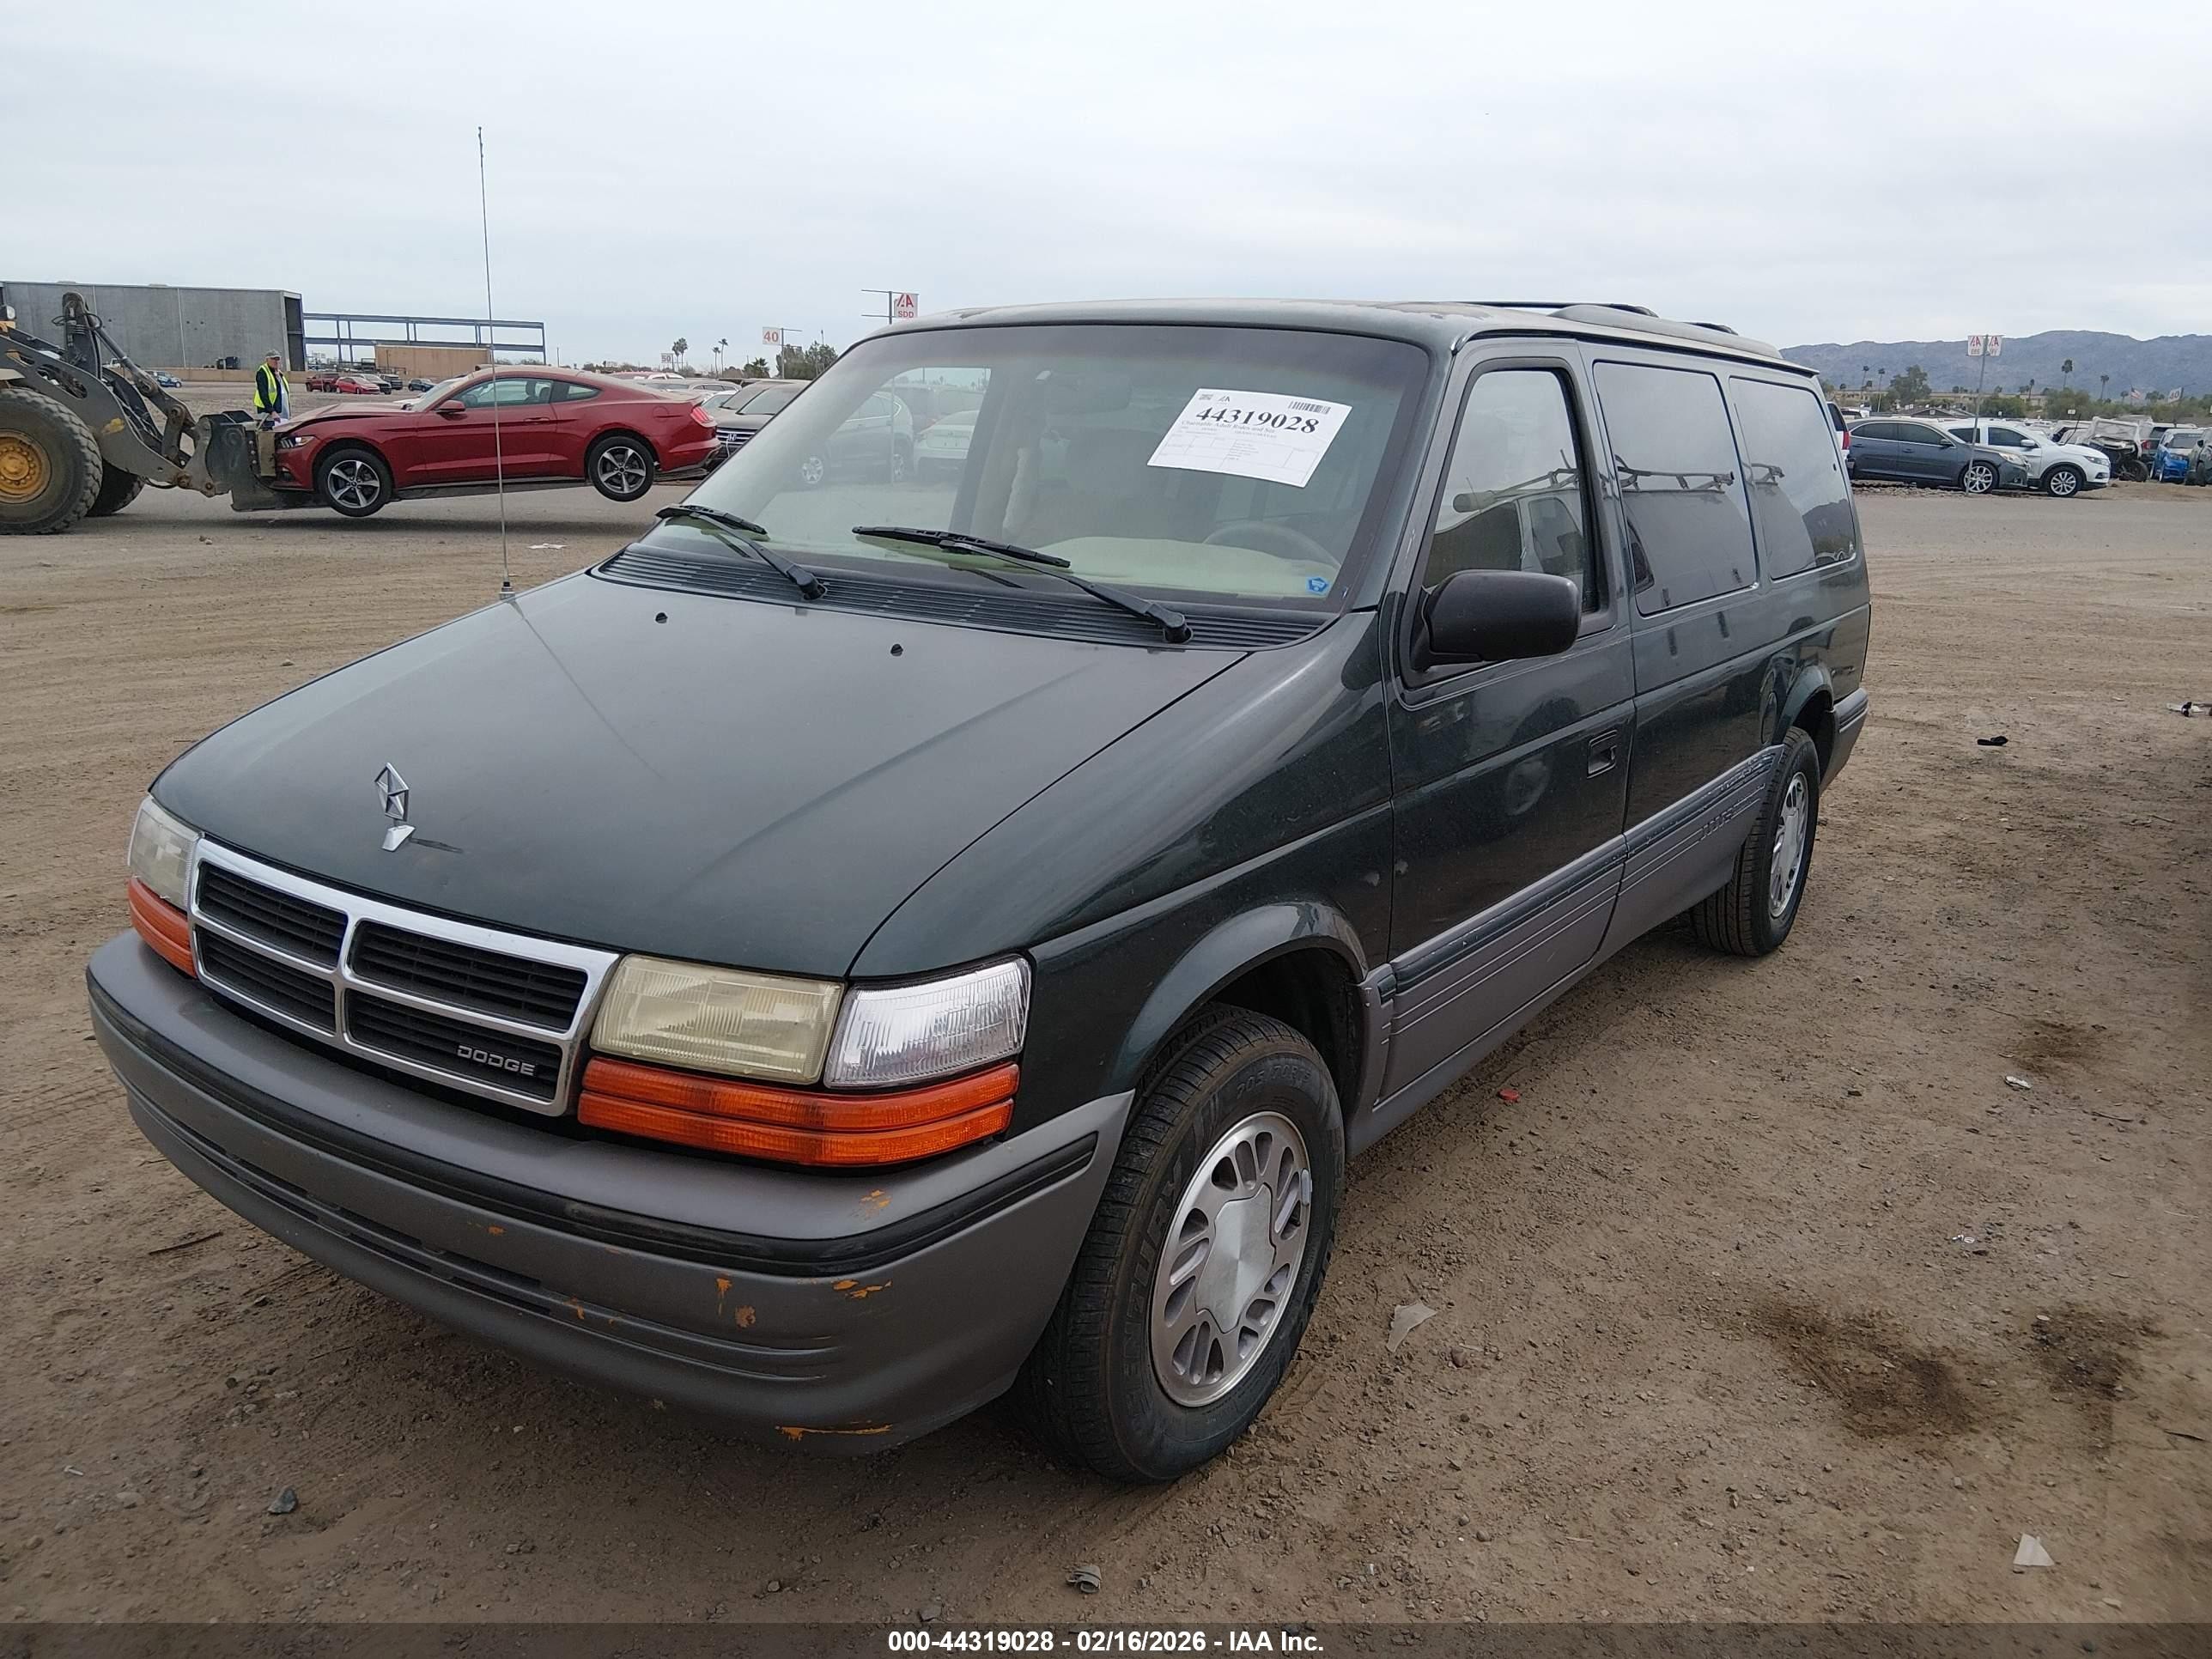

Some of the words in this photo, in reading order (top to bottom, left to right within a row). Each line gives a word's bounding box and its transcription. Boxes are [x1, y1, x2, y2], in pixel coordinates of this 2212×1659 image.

[763, 331, 780, 343] 40
[1195, 406, 1320, 434] 44319028
[457, 1045, 536, 1076] DODGE
